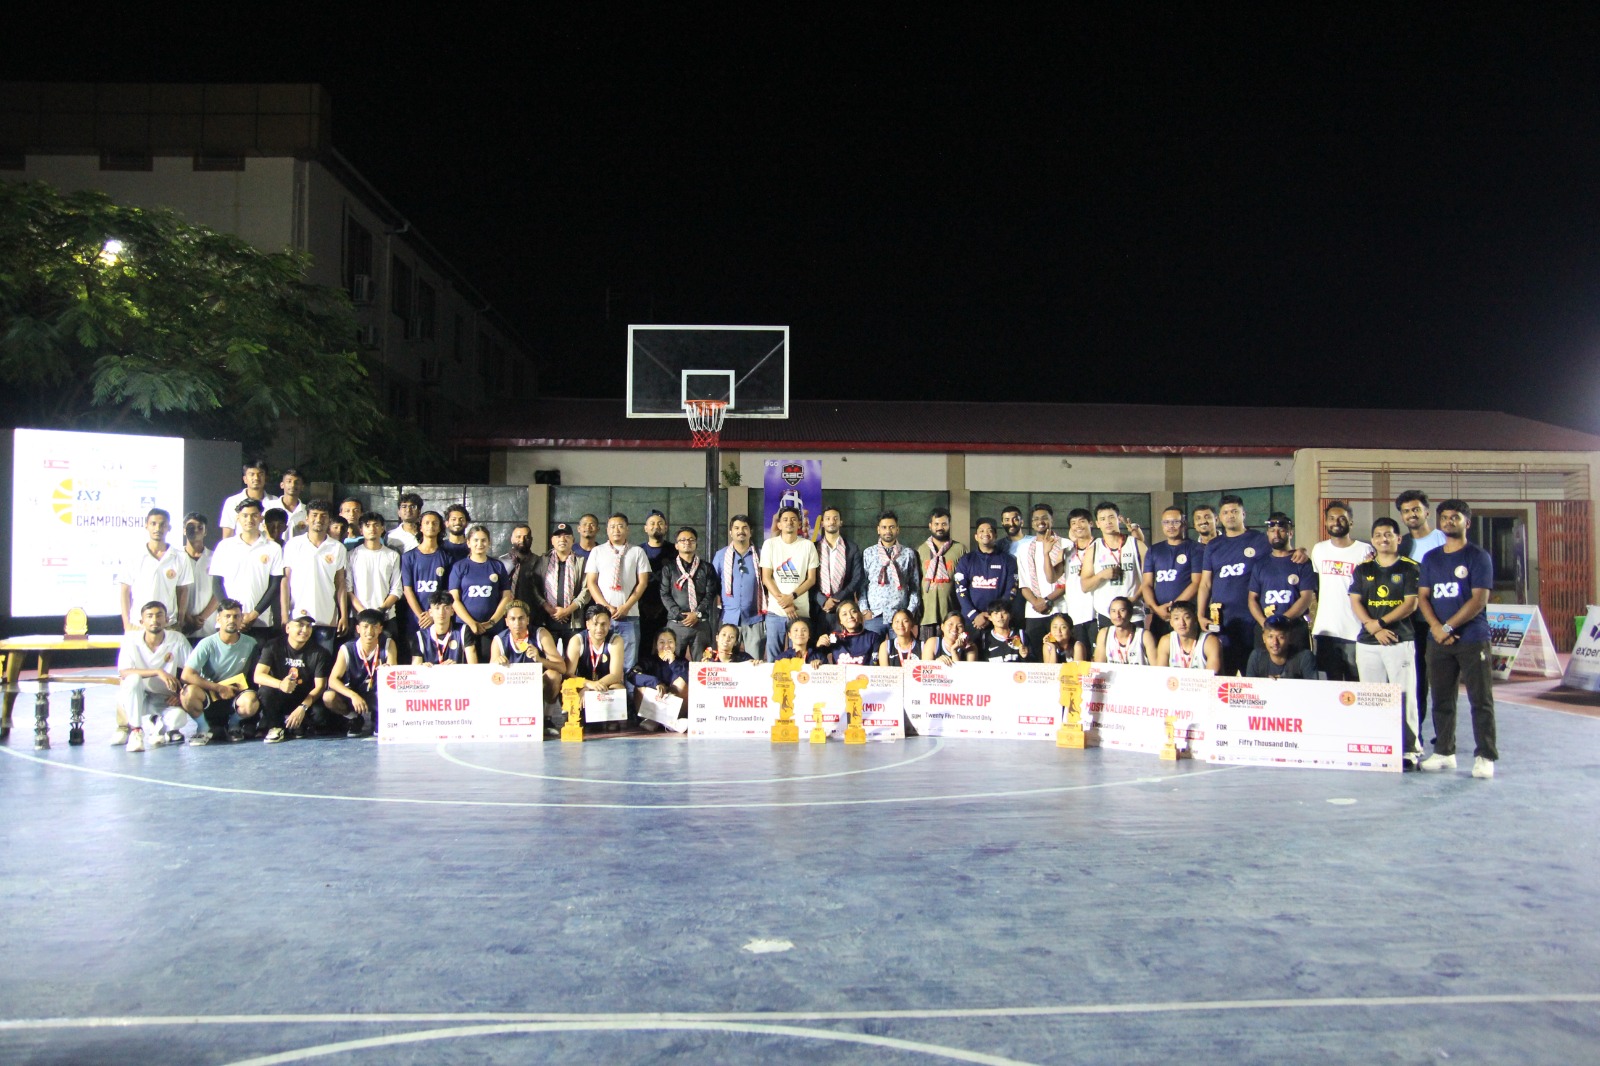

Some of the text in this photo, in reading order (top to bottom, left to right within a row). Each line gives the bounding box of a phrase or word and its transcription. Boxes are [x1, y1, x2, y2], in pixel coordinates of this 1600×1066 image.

[406, 698, 470, 712] RUNNER UP
[723, 695, 768, 708] WINNER
[929, 692, 991, 707] RUNNER UP
[862, 703, 886, 713] (MVP)
[1085, 702, 1194, 720] MOST VALUABLE PLAYER (MVP)
[925, 711, 944, 719] Twenty
[1247, 715, 1303, 733] WINNER
[1238, 738, 1253, 746] Fifty
[1254, 739, 1283, 748] Thousand
